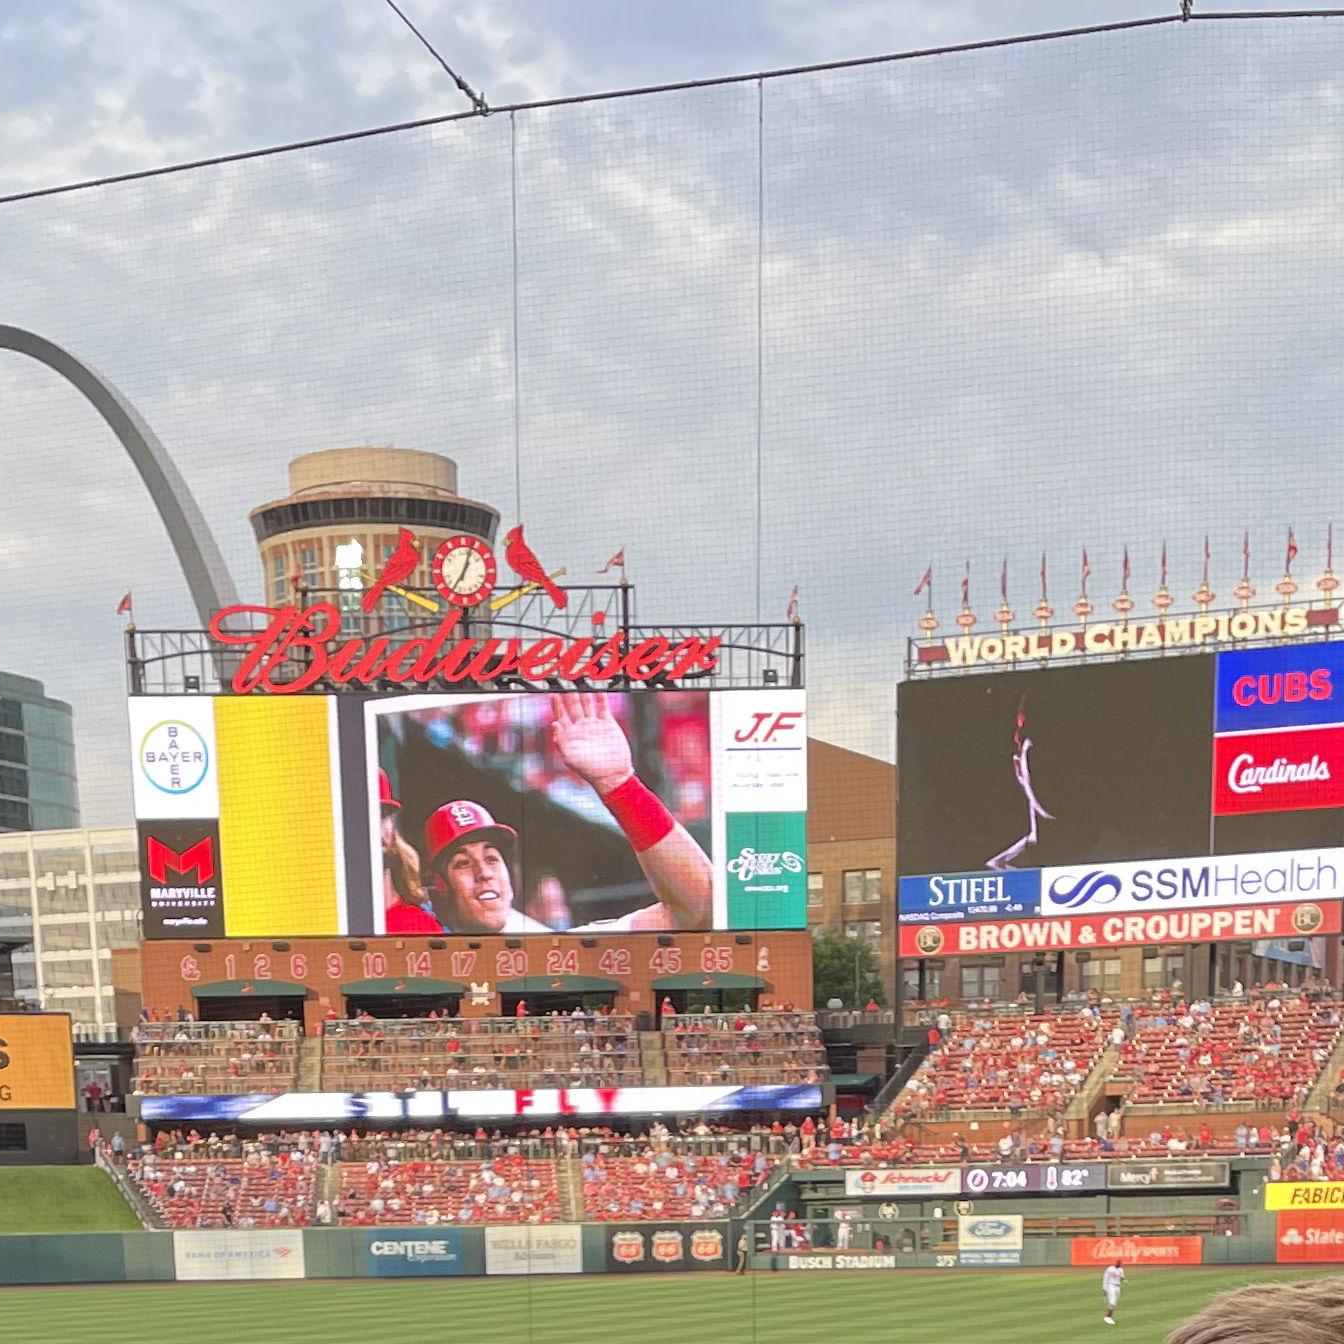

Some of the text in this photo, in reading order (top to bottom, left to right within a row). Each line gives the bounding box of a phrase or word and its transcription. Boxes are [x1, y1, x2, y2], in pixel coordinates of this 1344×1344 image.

[209, 604, 722, 694] Budweiser
[945, 607, 1310, 667] WORLD CHAMPIONS
[1232, 668, 1333, 707] CUBS
[146, 751, 203, 763] BAYER
[1228, 753, 1331, 794] Cardinals
[150, 887, 216, 899] MARYVILLE
[959, 921, 1071, 950] BROWN
[1078, 925, 1097, 944] &
[225, 954, 236, 980] 1
[254, 953, 271, 979] 2
[290, 954, 306, 979] 6
[326, 953, 343, 979] 9
[362, 952, 388, 978] 10
[406, 952, 432, 978] 14
[451, 951, 477, 977] 17
[496, 950, 528, 976] 20
[547, 950, 578, 975] 24
[598, 949, 631, 975] 42
[649, 948, 682, 974] 45
[701, 947, 733, 973] 85
[991, 1170, 1027, 1187] 7:04
[371, 1240, 449, 1257] CENTENE
[789, 1254, 895, 1269] BUSCH STADIUM
